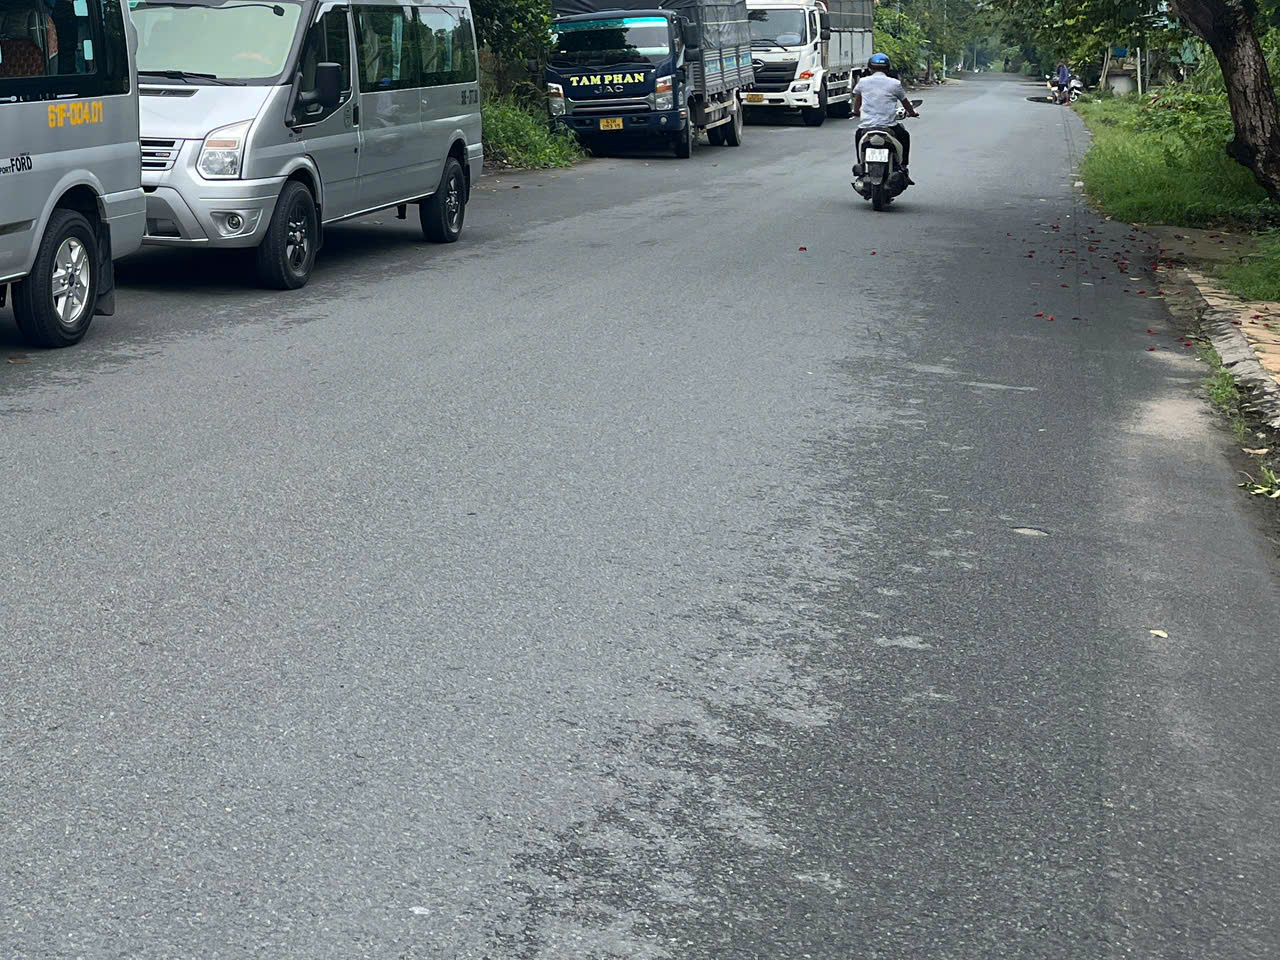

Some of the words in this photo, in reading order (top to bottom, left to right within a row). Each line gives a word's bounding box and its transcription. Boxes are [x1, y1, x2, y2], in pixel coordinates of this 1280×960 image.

[569, 74, 602, 86] TAM
[604, 72, 645, 84] PHAN
[594, 85, 624, 94] JAC
[47, 100, 105, 129] 61F-004.01
[10, 155, 33, 173] FORD
